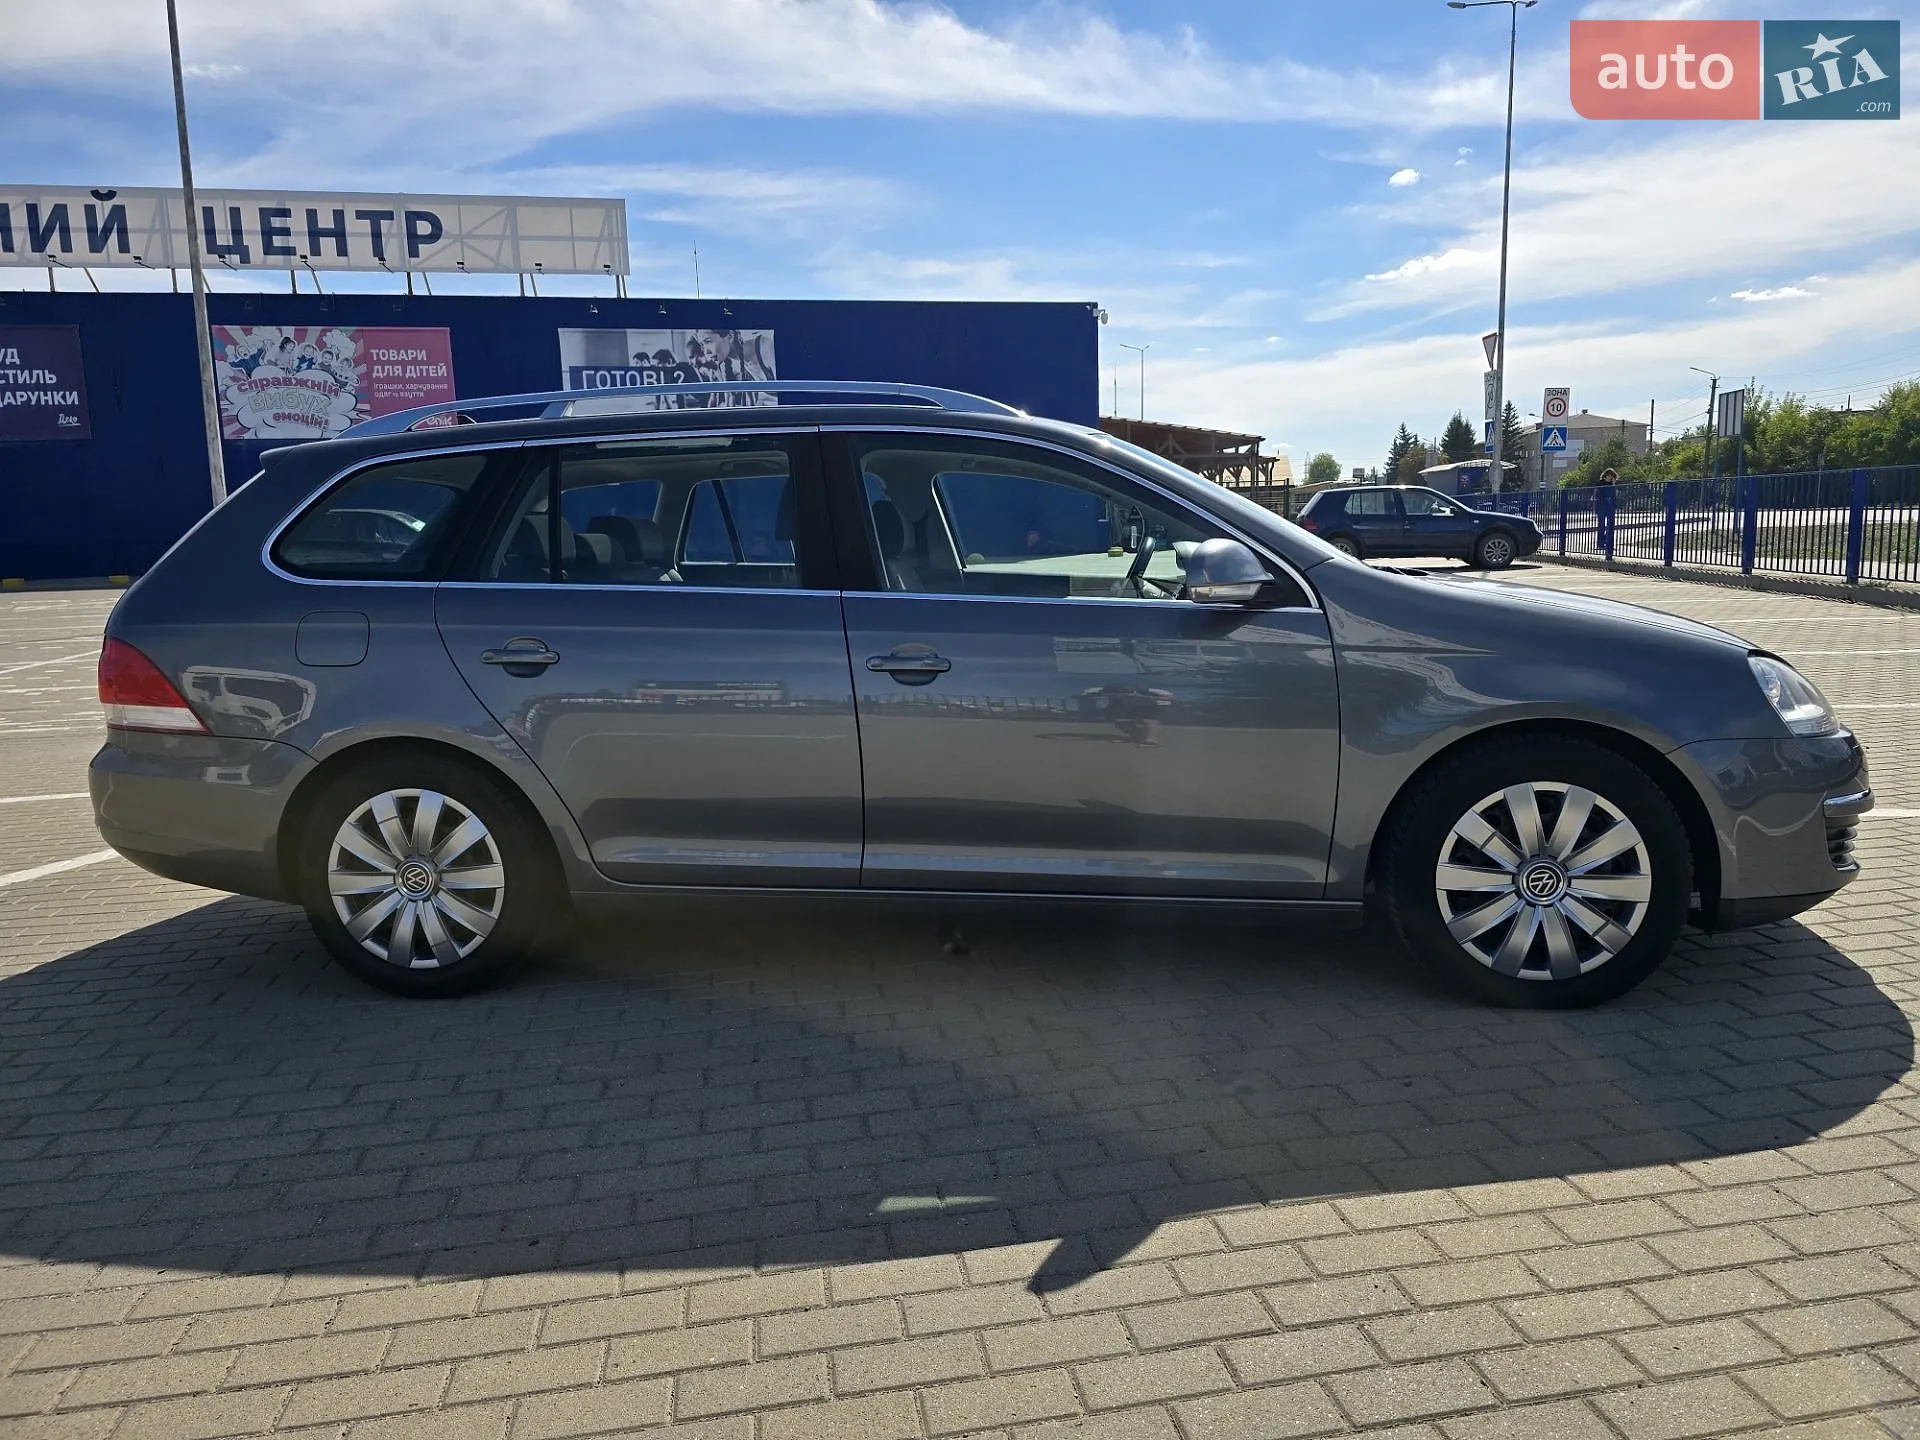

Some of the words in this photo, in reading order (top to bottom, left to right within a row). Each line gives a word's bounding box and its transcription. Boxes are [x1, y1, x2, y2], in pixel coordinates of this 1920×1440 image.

[0, 189, 131, 253] ИЙ
[202, 206, 443, 264] ЦЕНТР
[370, 349, 427, 361] ТОВАРИ
[372, 365, 402, 378] ДЛЯ
[405, 363, 447, 378] ДІТЕЙ
[237, 376, 340, 397] справжній
[0, 391, 79, 408] АРУНКИ
[1551, 402, 1562, 412] 10
[272, 412, 329, 431] емоцій!
